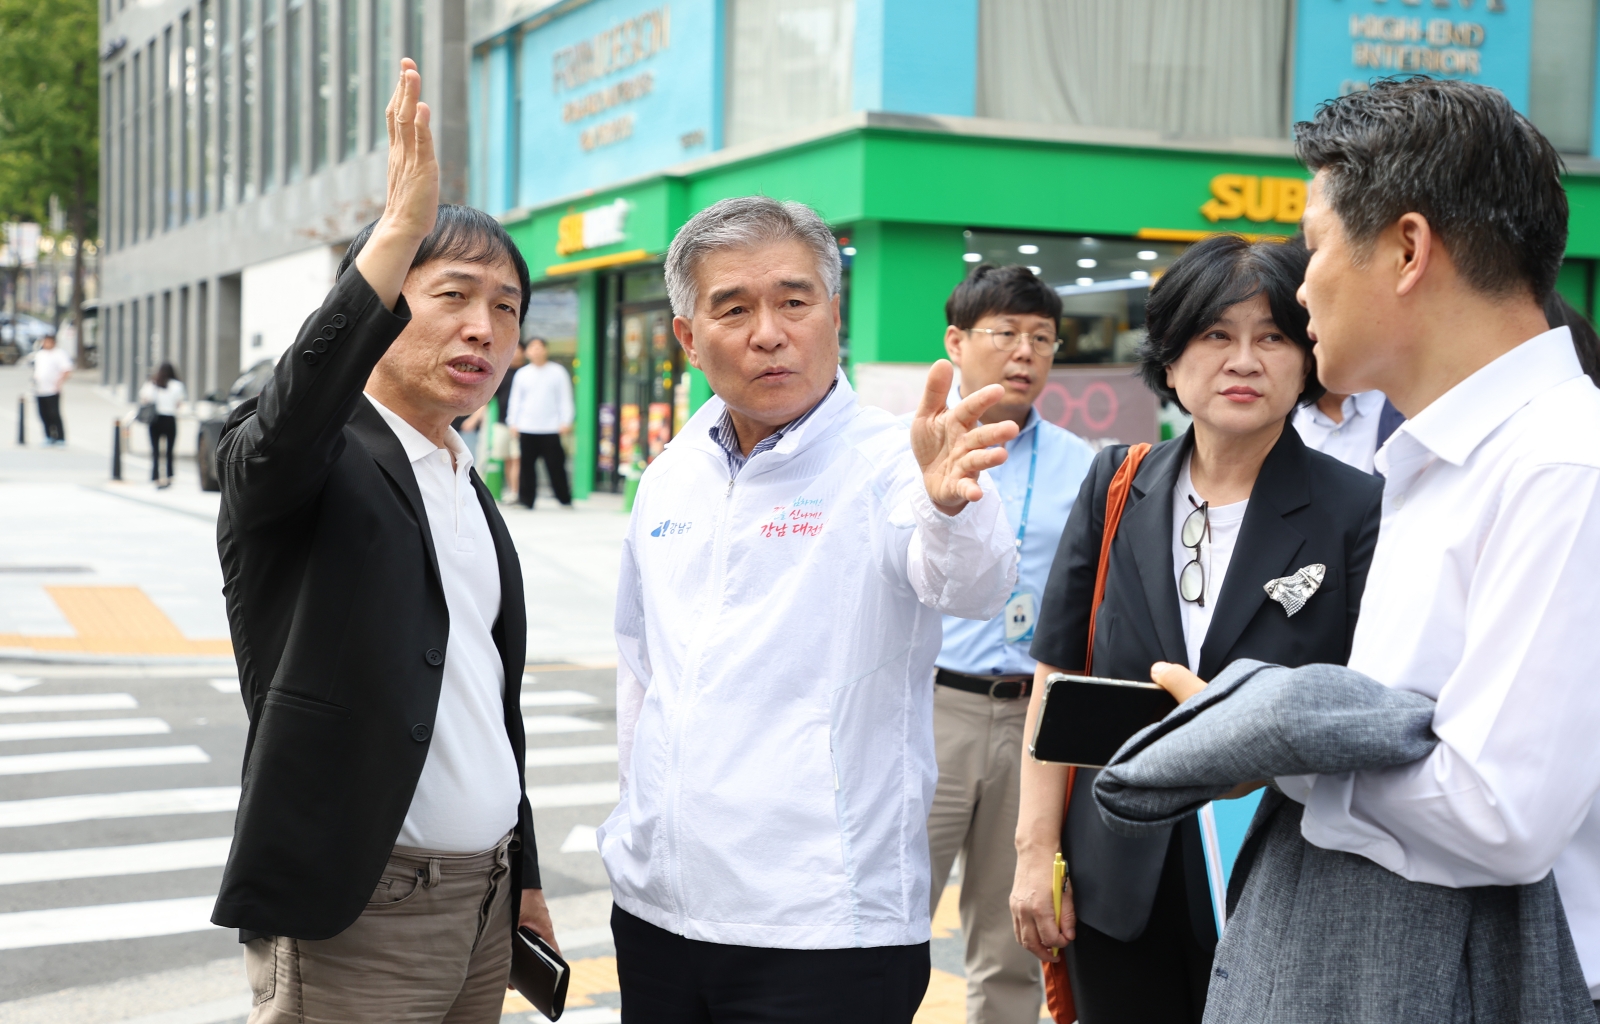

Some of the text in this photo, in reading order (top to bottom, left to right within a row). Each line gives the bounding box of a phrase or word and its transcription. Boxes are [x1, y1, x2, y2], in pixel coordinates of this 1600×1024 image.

[1350, 14, 1484, 47] HIGH-END
[1353, 45, 1482, 74] INTERIOR
[1200, 173, 1308, 223] SUB
[789, 510, 822, 520] 신나게!
[670, 522, 692, 534] 강남구
[760, 522, 787, 537] 강남
